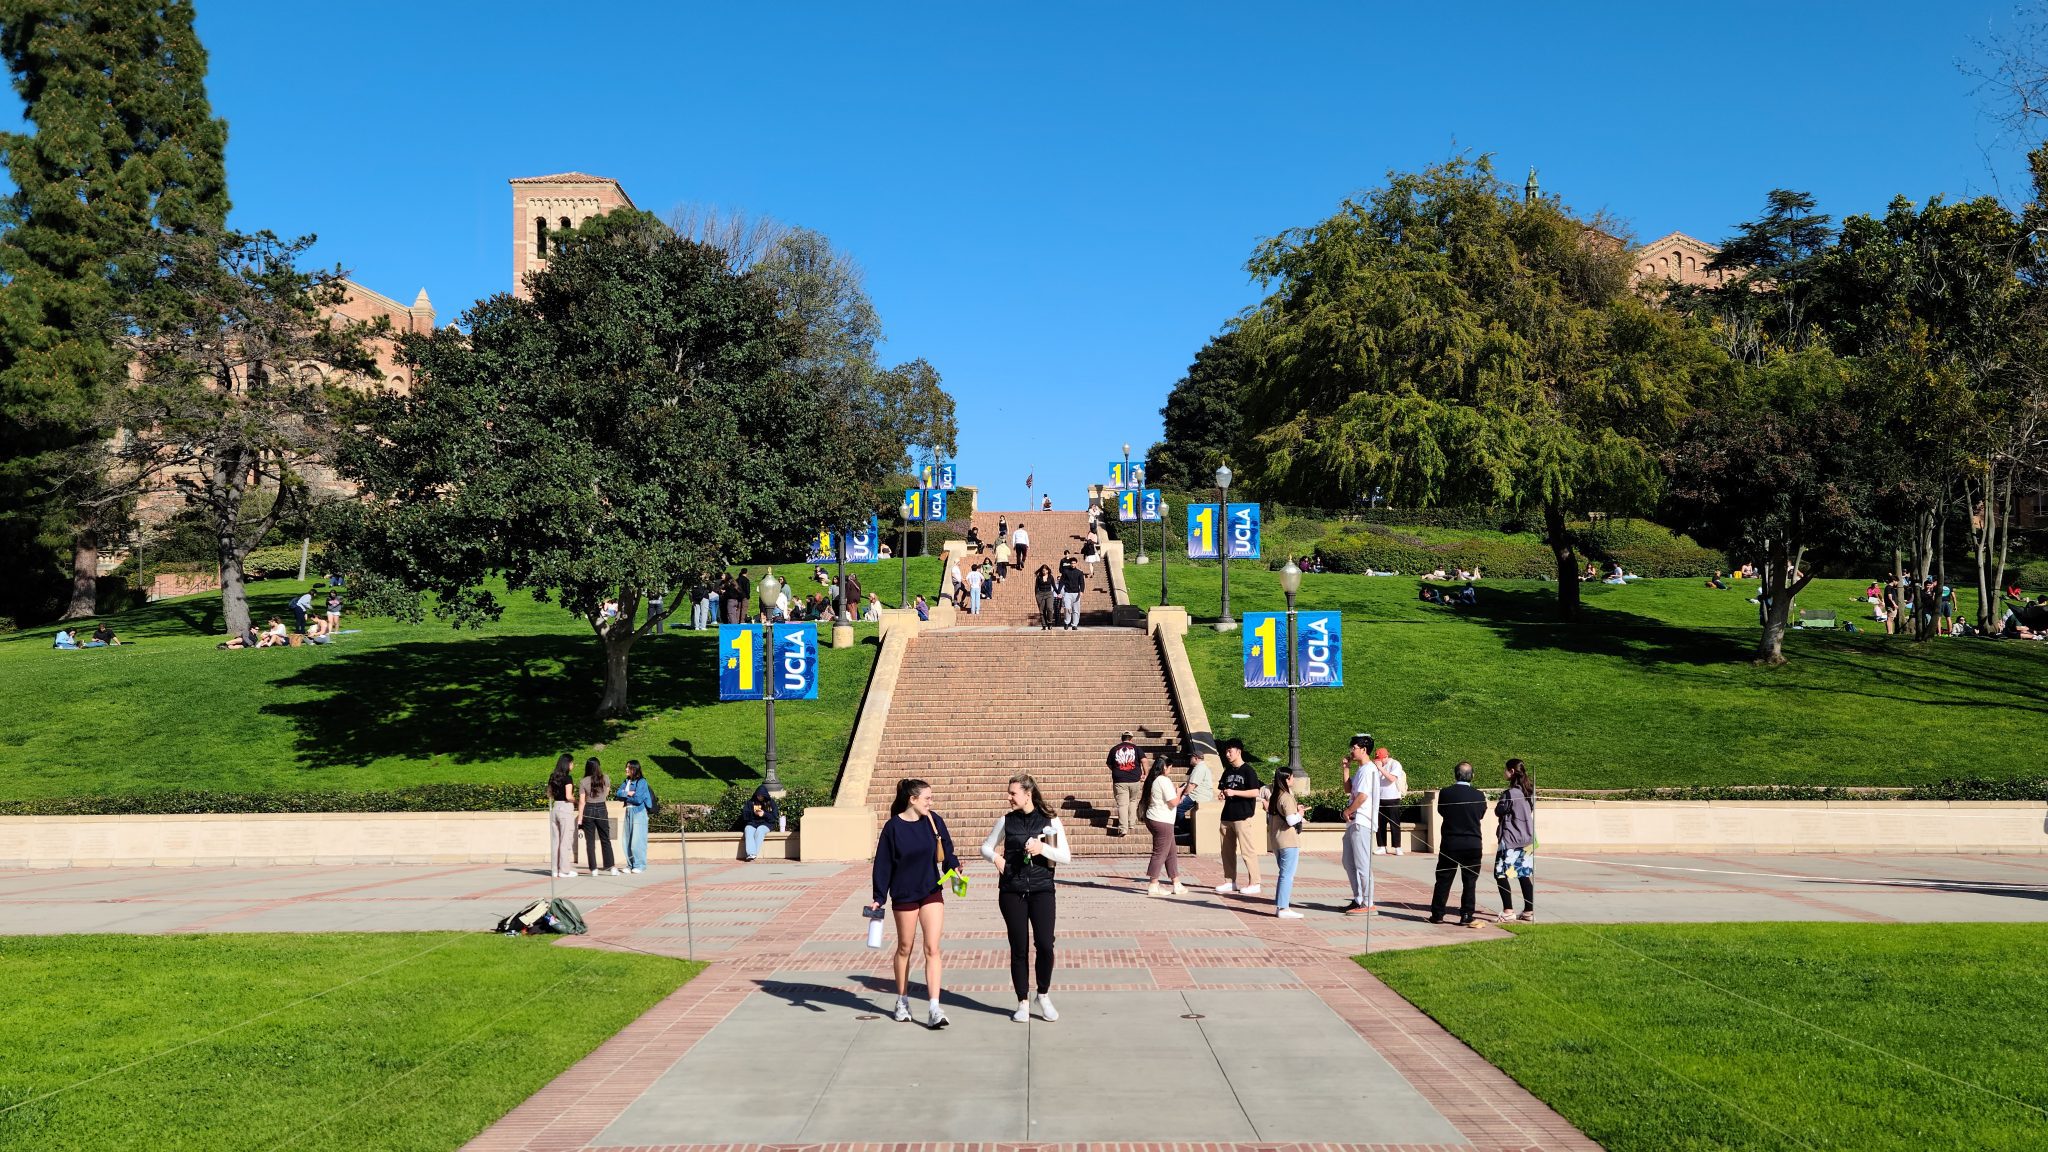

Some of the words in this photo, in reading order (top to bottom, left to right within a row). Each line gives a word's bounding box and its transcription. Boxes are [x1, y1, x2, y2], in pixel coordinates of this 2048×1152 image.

[943, 466, 952, 488] UCLA
[932, 493, 942, 518] UCLA
[1123, 492, 1133, 518] #1
[1146, 492, 1156, 518] UCLA
[1193, 508, 1213, 551] #1
[1235, 508, 1251, 551] UCLA
[727, 629, 753, 690] #1
[784, 629, 806, 690] UCLA
[1251, 617, 1277, 678] #1
[1307, 617, 1330, 678] UCLA
